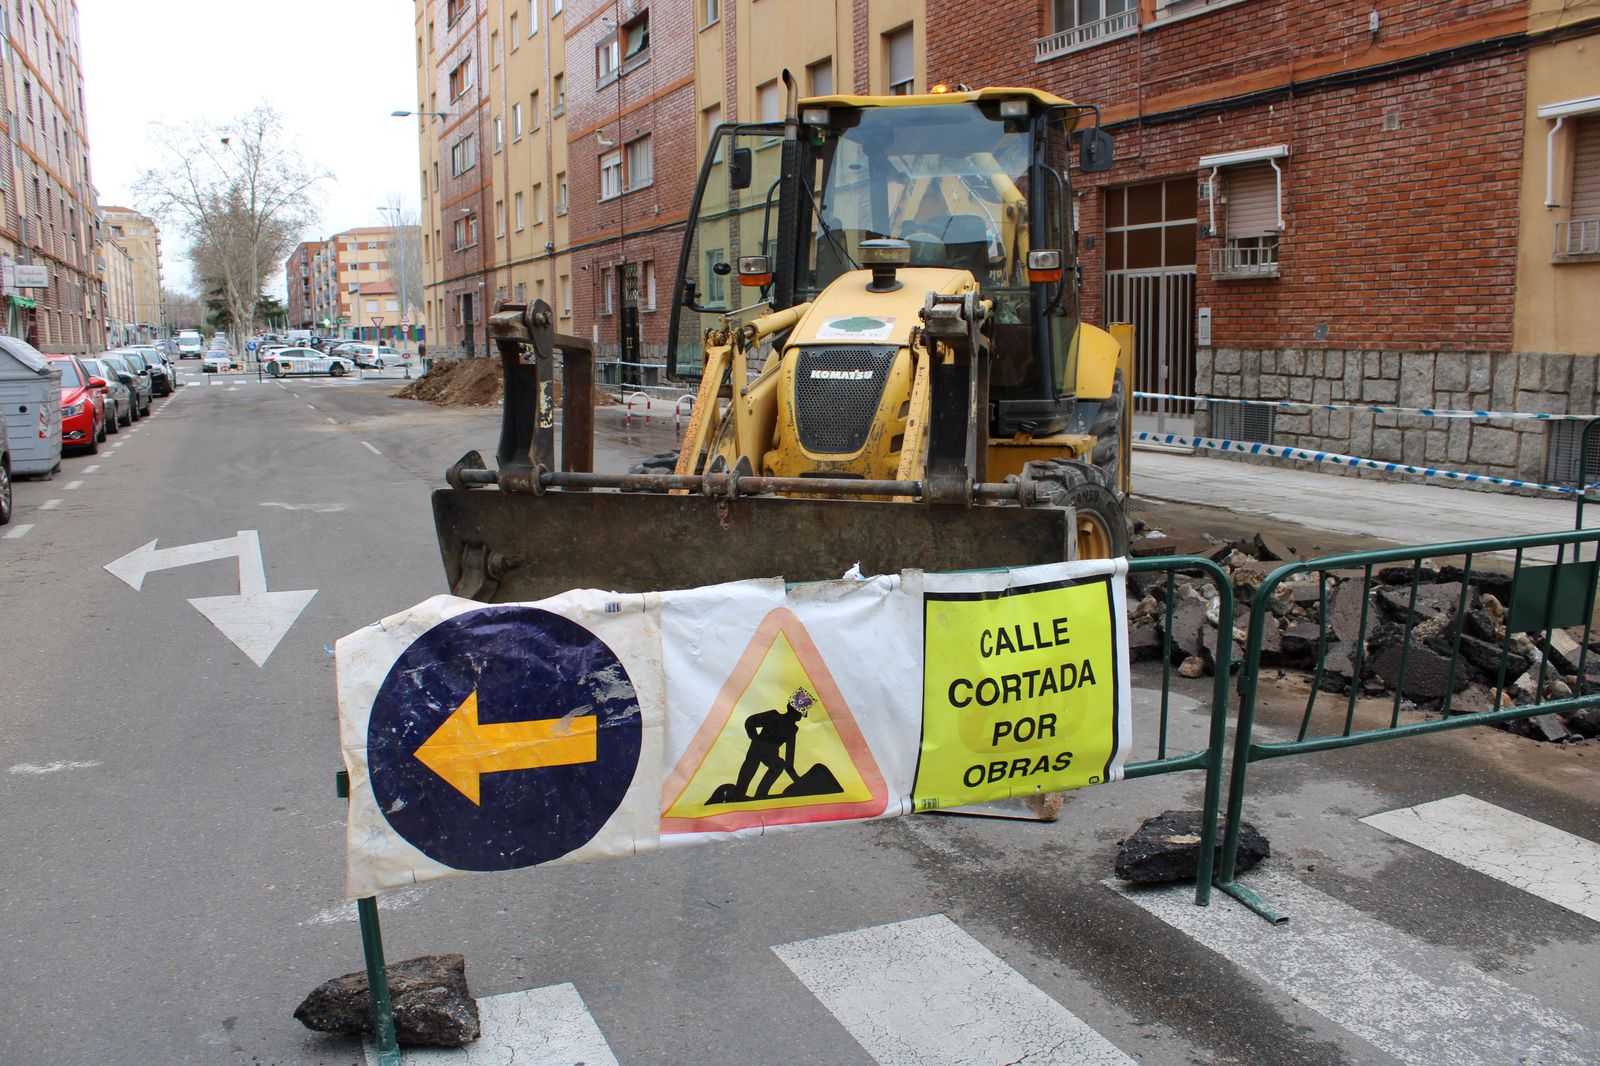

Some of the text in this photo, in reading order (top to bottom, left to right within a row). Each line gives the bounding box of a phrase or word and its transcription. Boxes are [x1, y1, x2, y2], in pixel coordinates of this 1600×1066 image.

[811, 369, 873, 379] KOMATSU
[980, 617, 1070, 658] CALLE
[948, 659, 1096, 708] CORTADA
[992, 713, 1056, 747] POR
[963, 751, 1073, 788] OBRAS
